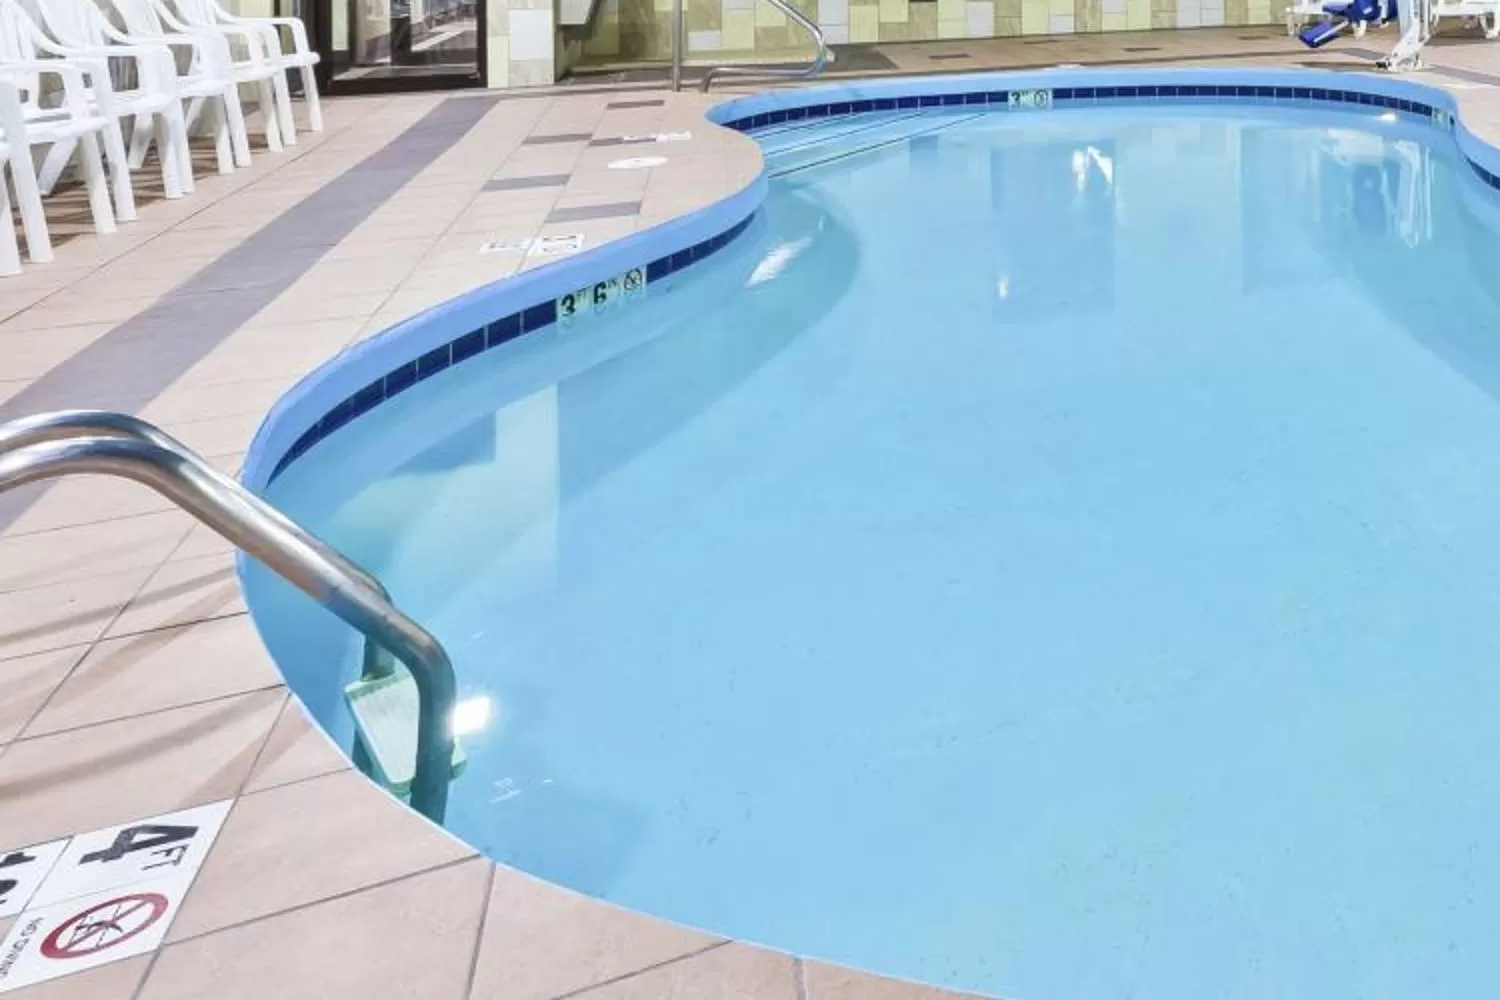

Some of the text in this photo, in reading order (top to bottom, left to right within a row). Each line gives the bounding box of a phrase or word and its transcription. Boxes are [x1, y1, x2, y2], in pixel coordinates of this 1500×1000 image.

[593, 281, 607, 304] 6
[77, 823, 200, 872] 4 FT
